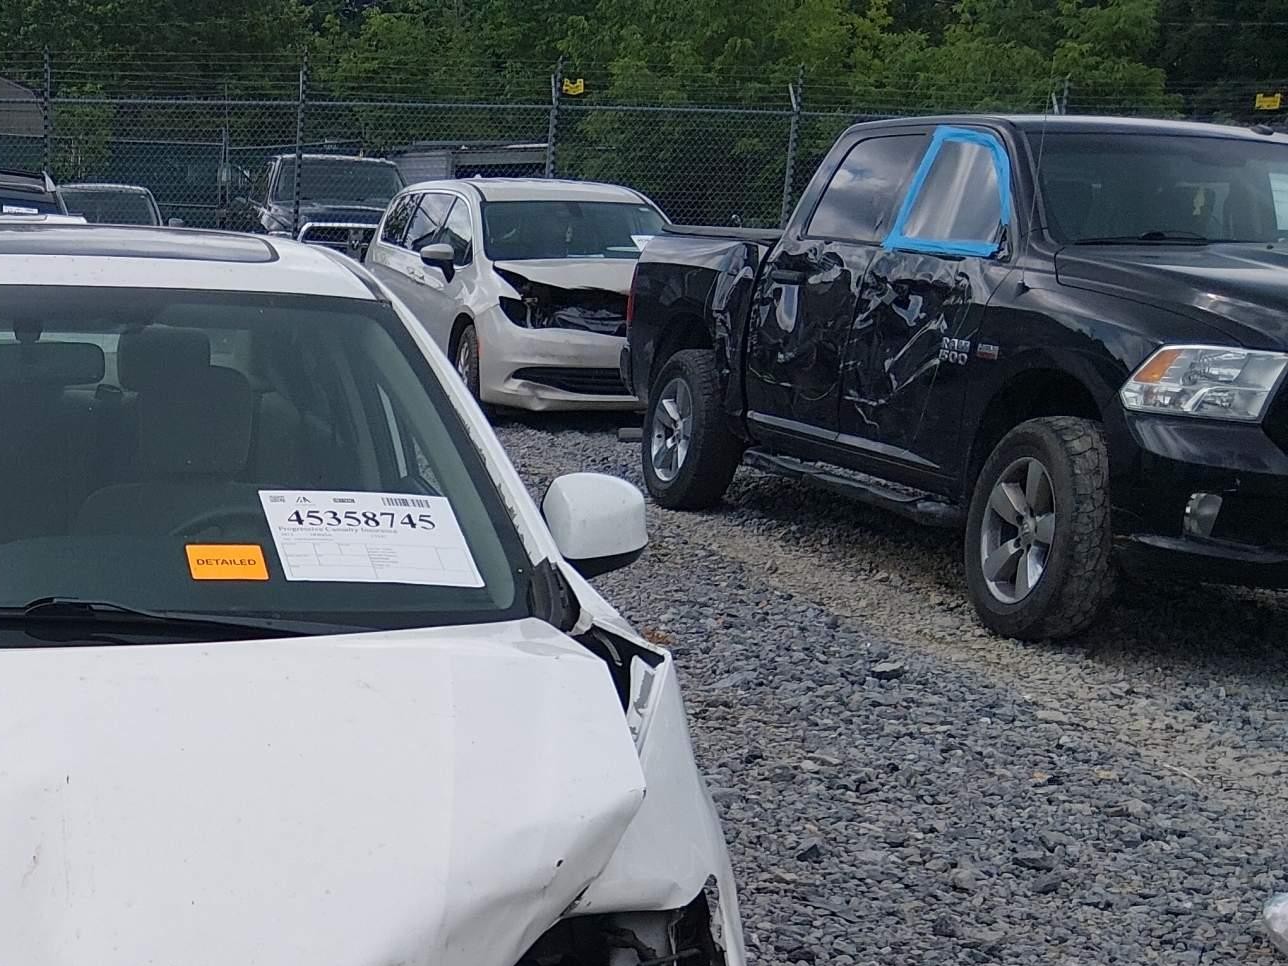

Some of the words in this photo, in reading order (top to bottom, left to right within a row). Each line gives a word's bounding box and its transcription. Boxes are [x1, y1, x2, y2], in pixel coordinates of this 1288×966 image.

[942, 336, 971, 353] RAM
[938, 348, 968, 366] 1500
[287, 509, 436, 531] 45358745
[196, 558, 257, 566] DETAILED
